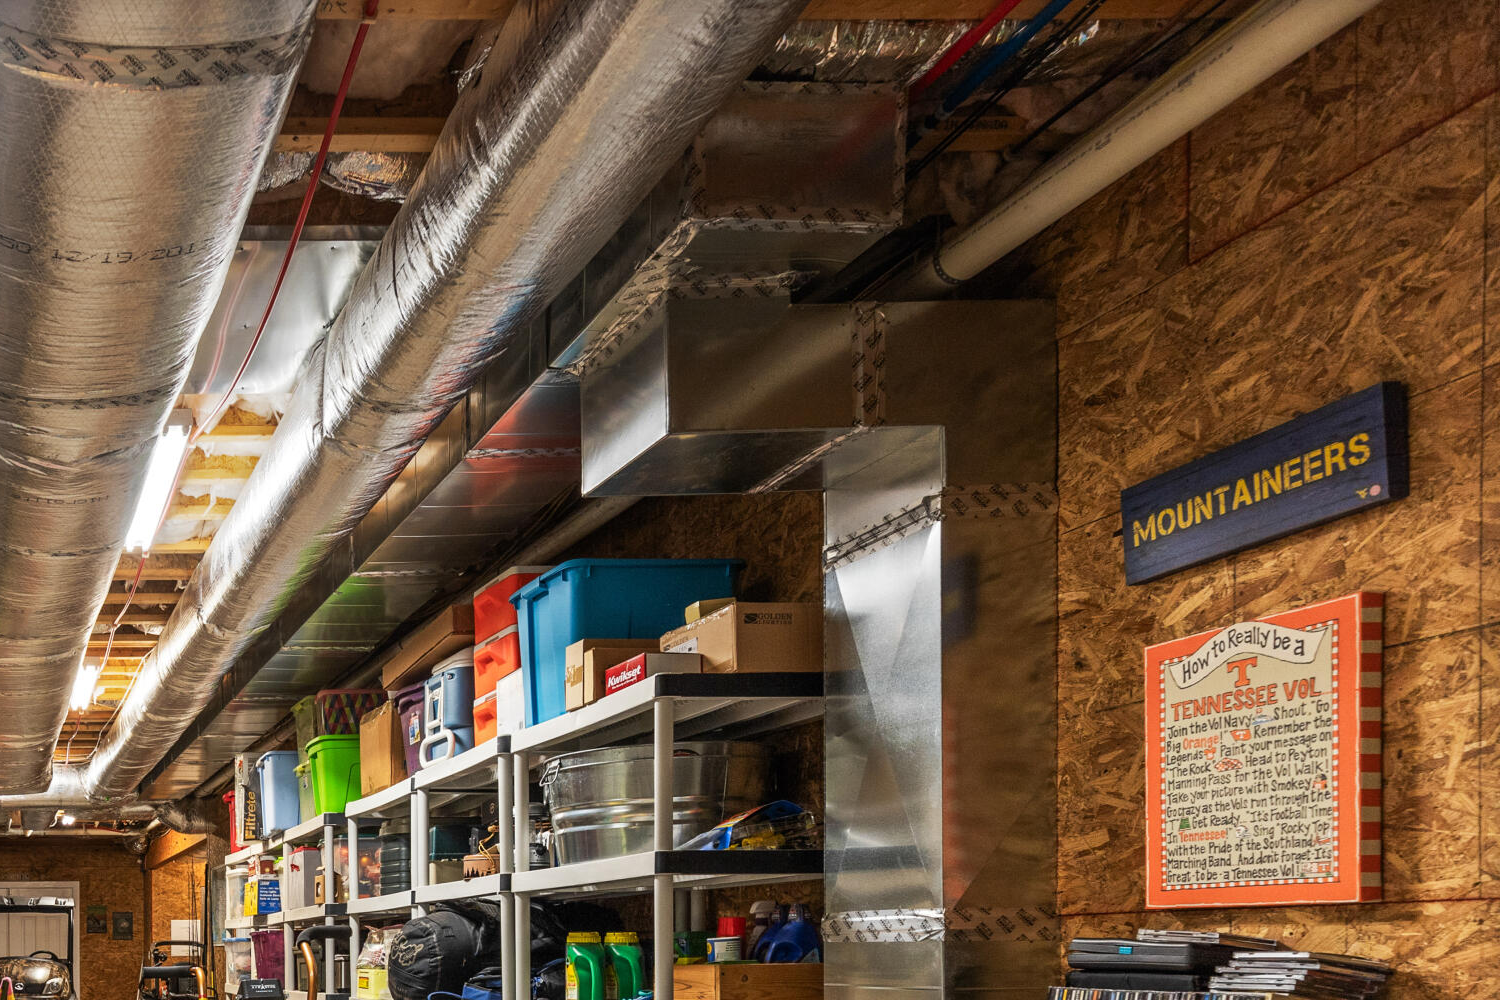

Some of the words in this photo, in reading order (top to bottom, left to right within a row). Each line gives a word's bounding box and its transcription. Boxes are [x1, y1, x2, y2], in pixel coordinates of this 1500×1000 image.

[1133, 432, 1371, 547] MOUNTAINEERS
[1182, 651, 1210, 683] How
[1211, 640, 1225, 657] to
[1228, 626, 1270, 648] Really
[1273, 629, 1291, 650] be
[1294, 639, 1305, 656] a
[607, 664, 642, 688] Kwikset
[1171, 683, 1278, 721] TENNESSEE
[1283, 677, 1322, 701] VOL
[1167, 726, 1188, 739] Join
[1189, 722, 1208, 734] the
[1208, 717, 1222, 730] Vol
[1167, 741, 1181, 753] Big
[1254, 721, 1311, 738] Remember
[1314, 716, 1332, 728] the
[1167, 751, 1203, 766] Legends
[1220, 743, 1246, 757] Paint
[1248, 741, 1272, 754] your
[1274, 733, 1317, 748] message
[1319, 731, 1332, 741] on
[1245, 752, 1272, 767] Head
[1275, 751, 1286, 763] to
[1288, 747, 1327, 762] Peyton
[1168, 777, 1206, 791] Manning
[1208, 774, 1231, 785] Pass
[1235, 770, 1249, 782] for
[1252, 768, 1272, 779] the
[1275, 764, 1290, 777] Vol
[1167, 792, 1188, 805] Take
[1190, 791, 1210, 804] your
[1211, 786, 1244, 800] picture
[1246, 782, 1268, 794] with
[1271, 778, 1312, 791] Smokey
[1202, 804, 1212, 813] as
[1214, 801, 1230, 812] the
[1251, 799, 1267, 809] run
[1269, 792, 1308, 807] through
[1311, 789, 1331, 802] the
[245, 791, 256, 840] Filtrete
[1192, 817, 1208, 829] Get
[1271, 807, 1307, 821] Football
[1308, 804, 1332, 818] Time
[1167, 832, 1177, 844] In
[1253, 824, 1274, 839] Sing
[1189, 844, 1205, 855] the
[1209, 841, 1232, 853] Pride
[1235, 839, 1244, 851] of
[1246, 839, 1261, 850] the
[1263, 834, 1313, 849] Southland
[1167, 857, 1206, 870] Marching
[1238, 853, 1254, 866] And
[1231, 867, 1279, 880] Tennessee
